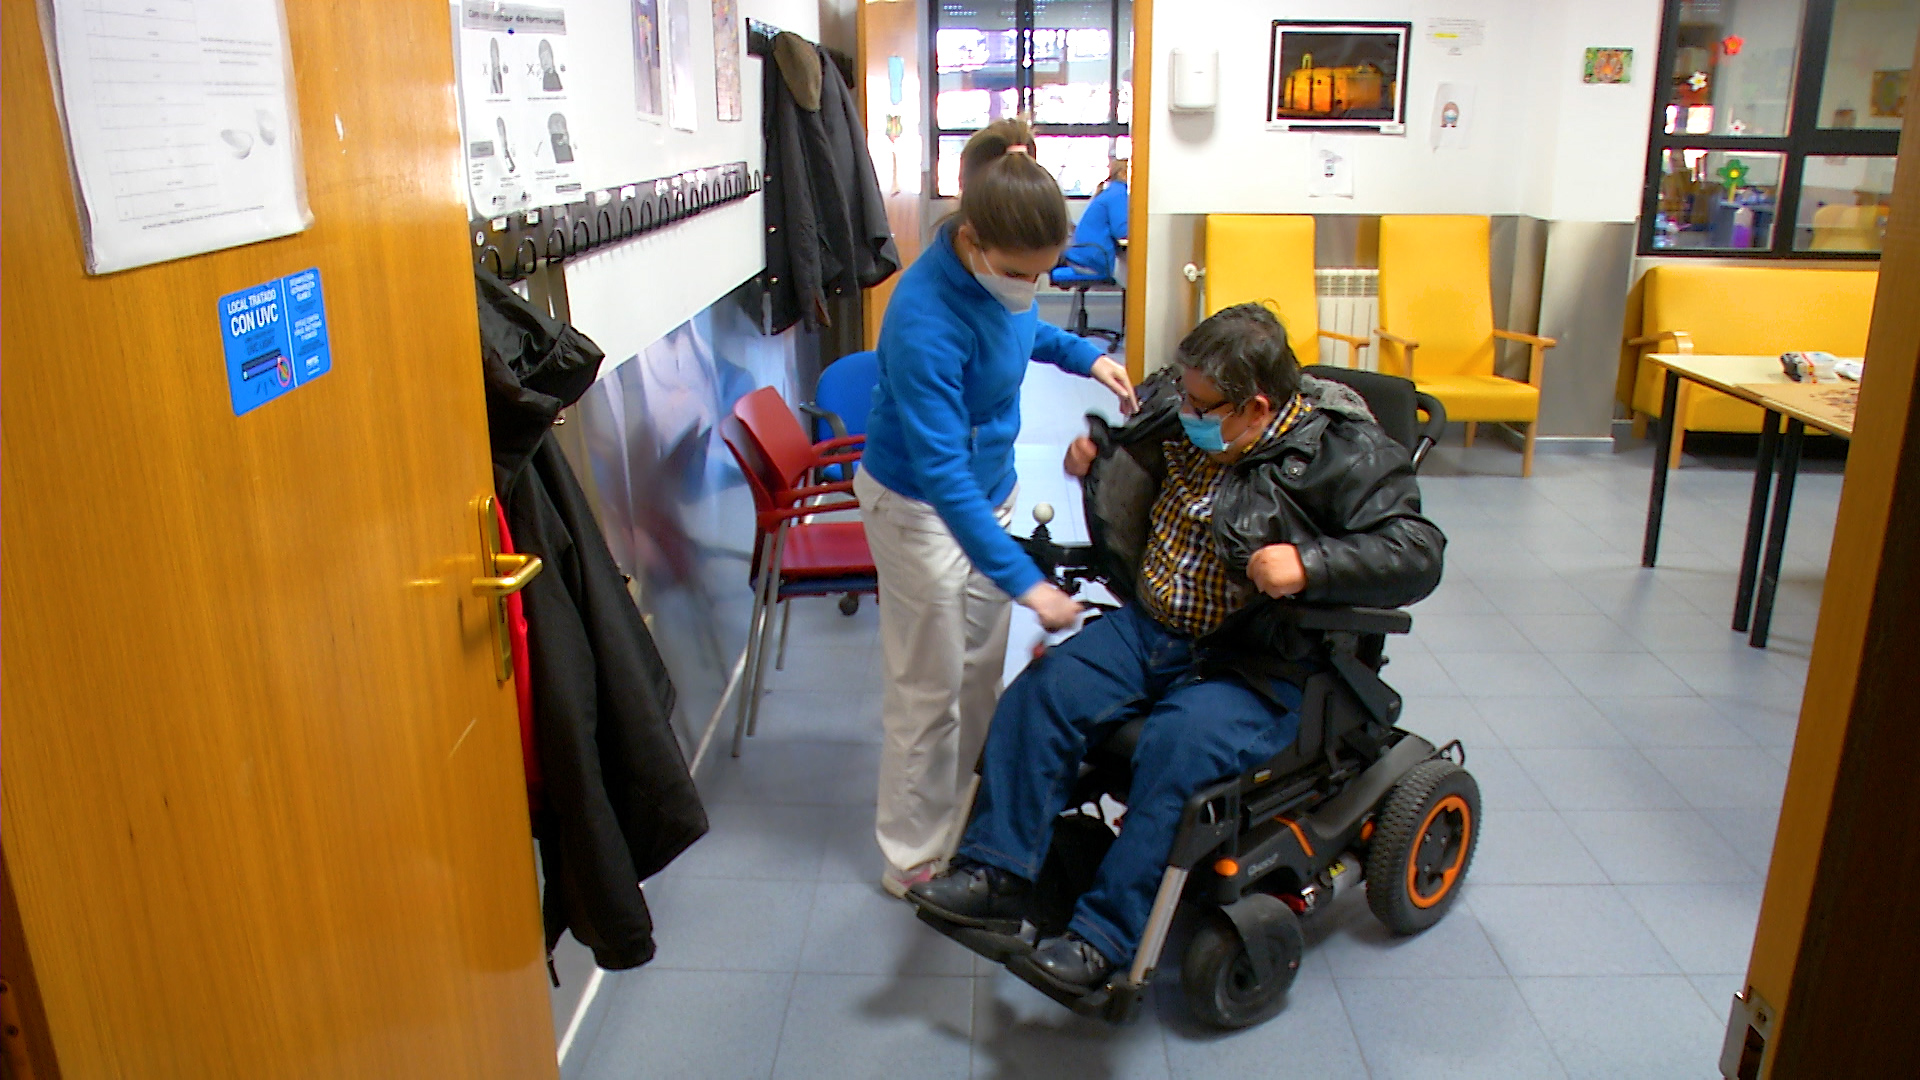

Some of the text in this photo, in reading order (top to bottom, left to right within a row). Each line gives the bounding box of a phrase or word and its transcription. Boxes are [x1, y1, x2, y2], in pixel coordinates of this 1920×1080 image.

[227, 298, 249, 316] LOCAL
[248, 287, 277, 308] TRATADO
[231, 310, 256, 337] CON
[255, 303, 279, 328] UVC
